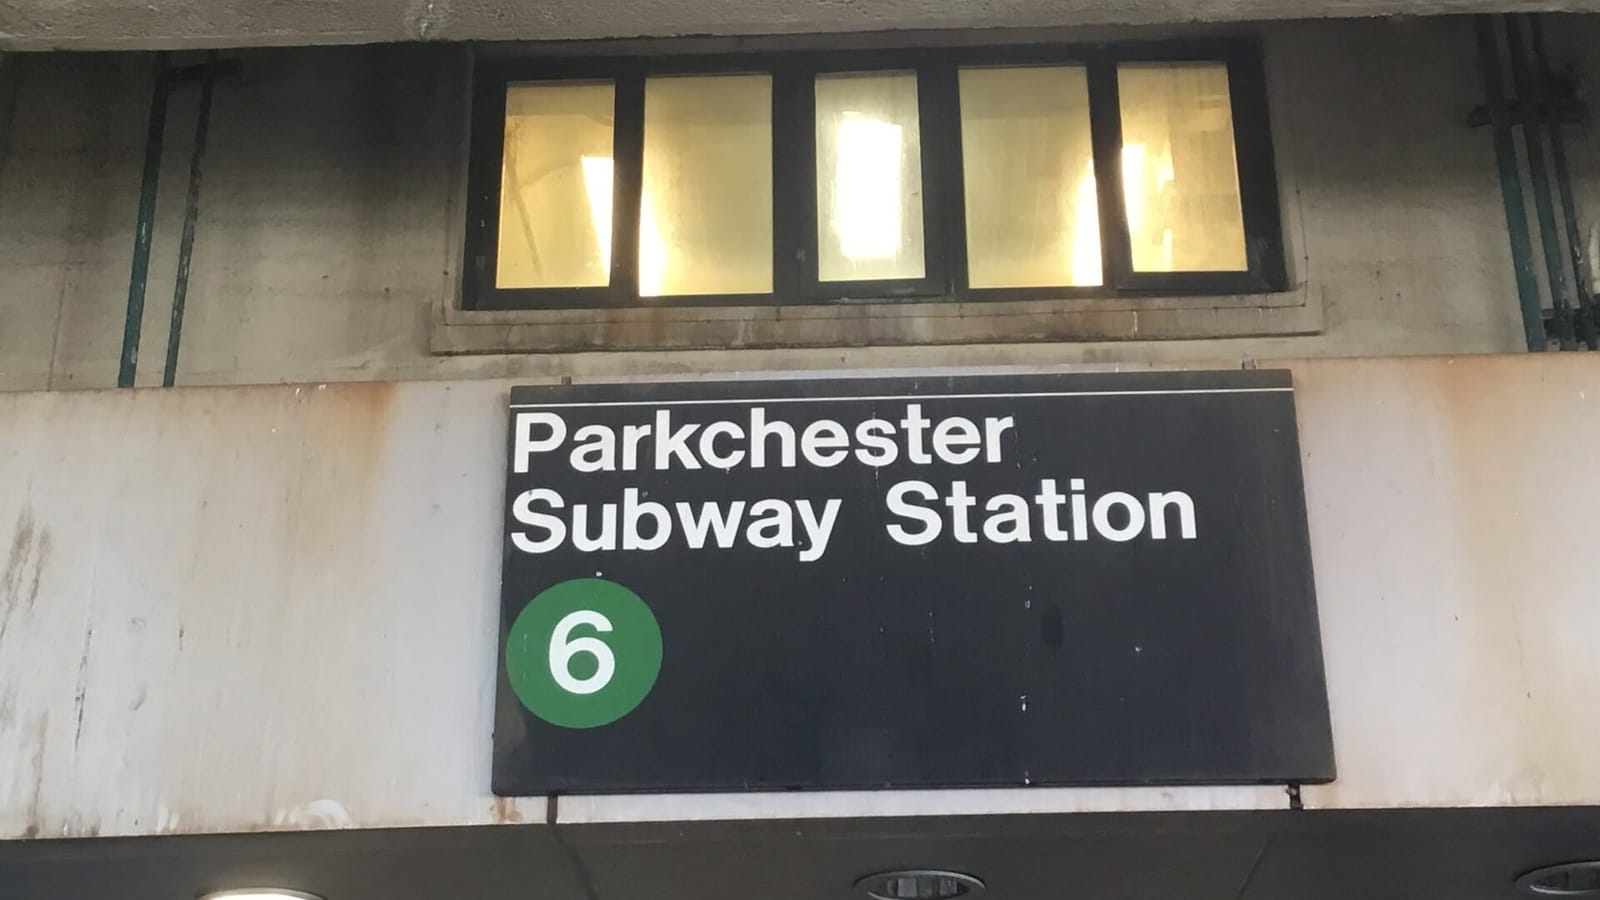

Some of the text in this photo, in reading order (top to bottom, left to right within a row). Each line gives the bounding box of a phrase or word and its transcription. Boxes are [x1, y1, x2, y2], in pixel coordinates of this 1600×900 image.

[513, 403, 1014, 474] Parkchester
[510, 478, 1197, 562] Subway Station
[548, 609, 616, 695] 6
